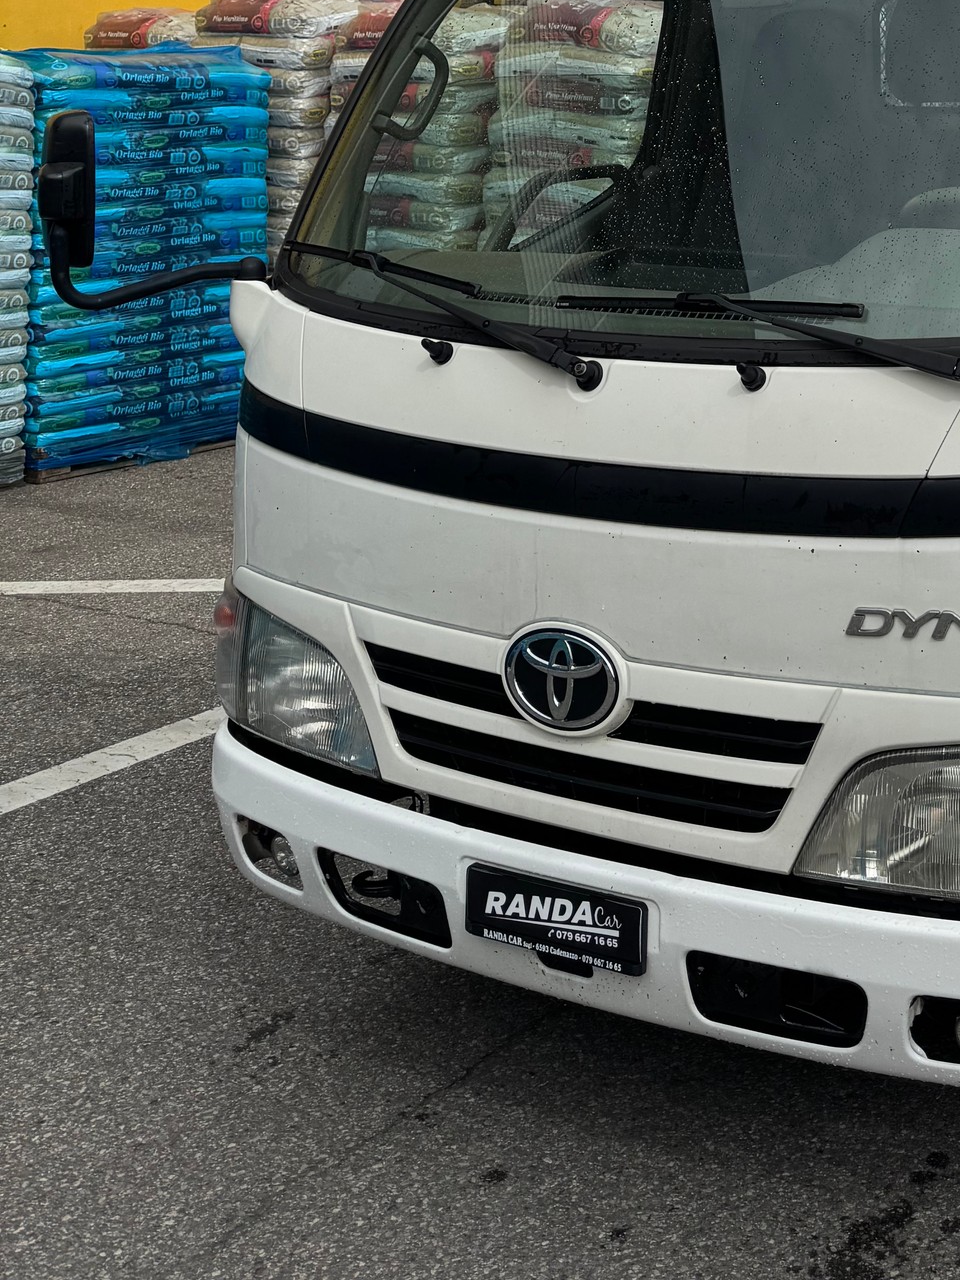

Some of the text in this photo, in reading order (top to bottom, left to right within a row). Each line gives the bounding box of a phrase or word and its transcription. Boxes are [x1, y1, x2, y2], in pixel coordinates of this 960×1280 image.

[122, 72, 169, 83] Ortaggi Bio
[211, 89, 224, 98] Bio
[145, 187, 159, 196] Bio
[202, 233, 216, 242] Bio
[151, 261, 166, 270] Bio
[204, 305, 216, 314] Bio
[150, 331, 164, 342] Bio
[148, 365, 162, 376] Bio
[202, 371, 215, 381] Bio
[148, 401, 162, 411] Bio
[485, 891, 622, 929] RANDA Car
[556, 930, 618, 948] 079 667 16 65
[484, 928, 508, 943] RANDA
[508, 934, 522, 946] CAR
[536, 942, 549, 953] 6593
[550, 946, 578, 960] Cadenazzo
[582, 954, 593, 964] 079
[594, 958, 604, 968] 667
[606, 960, 613, 970] 16
[614, 962, 622, 972] 65
